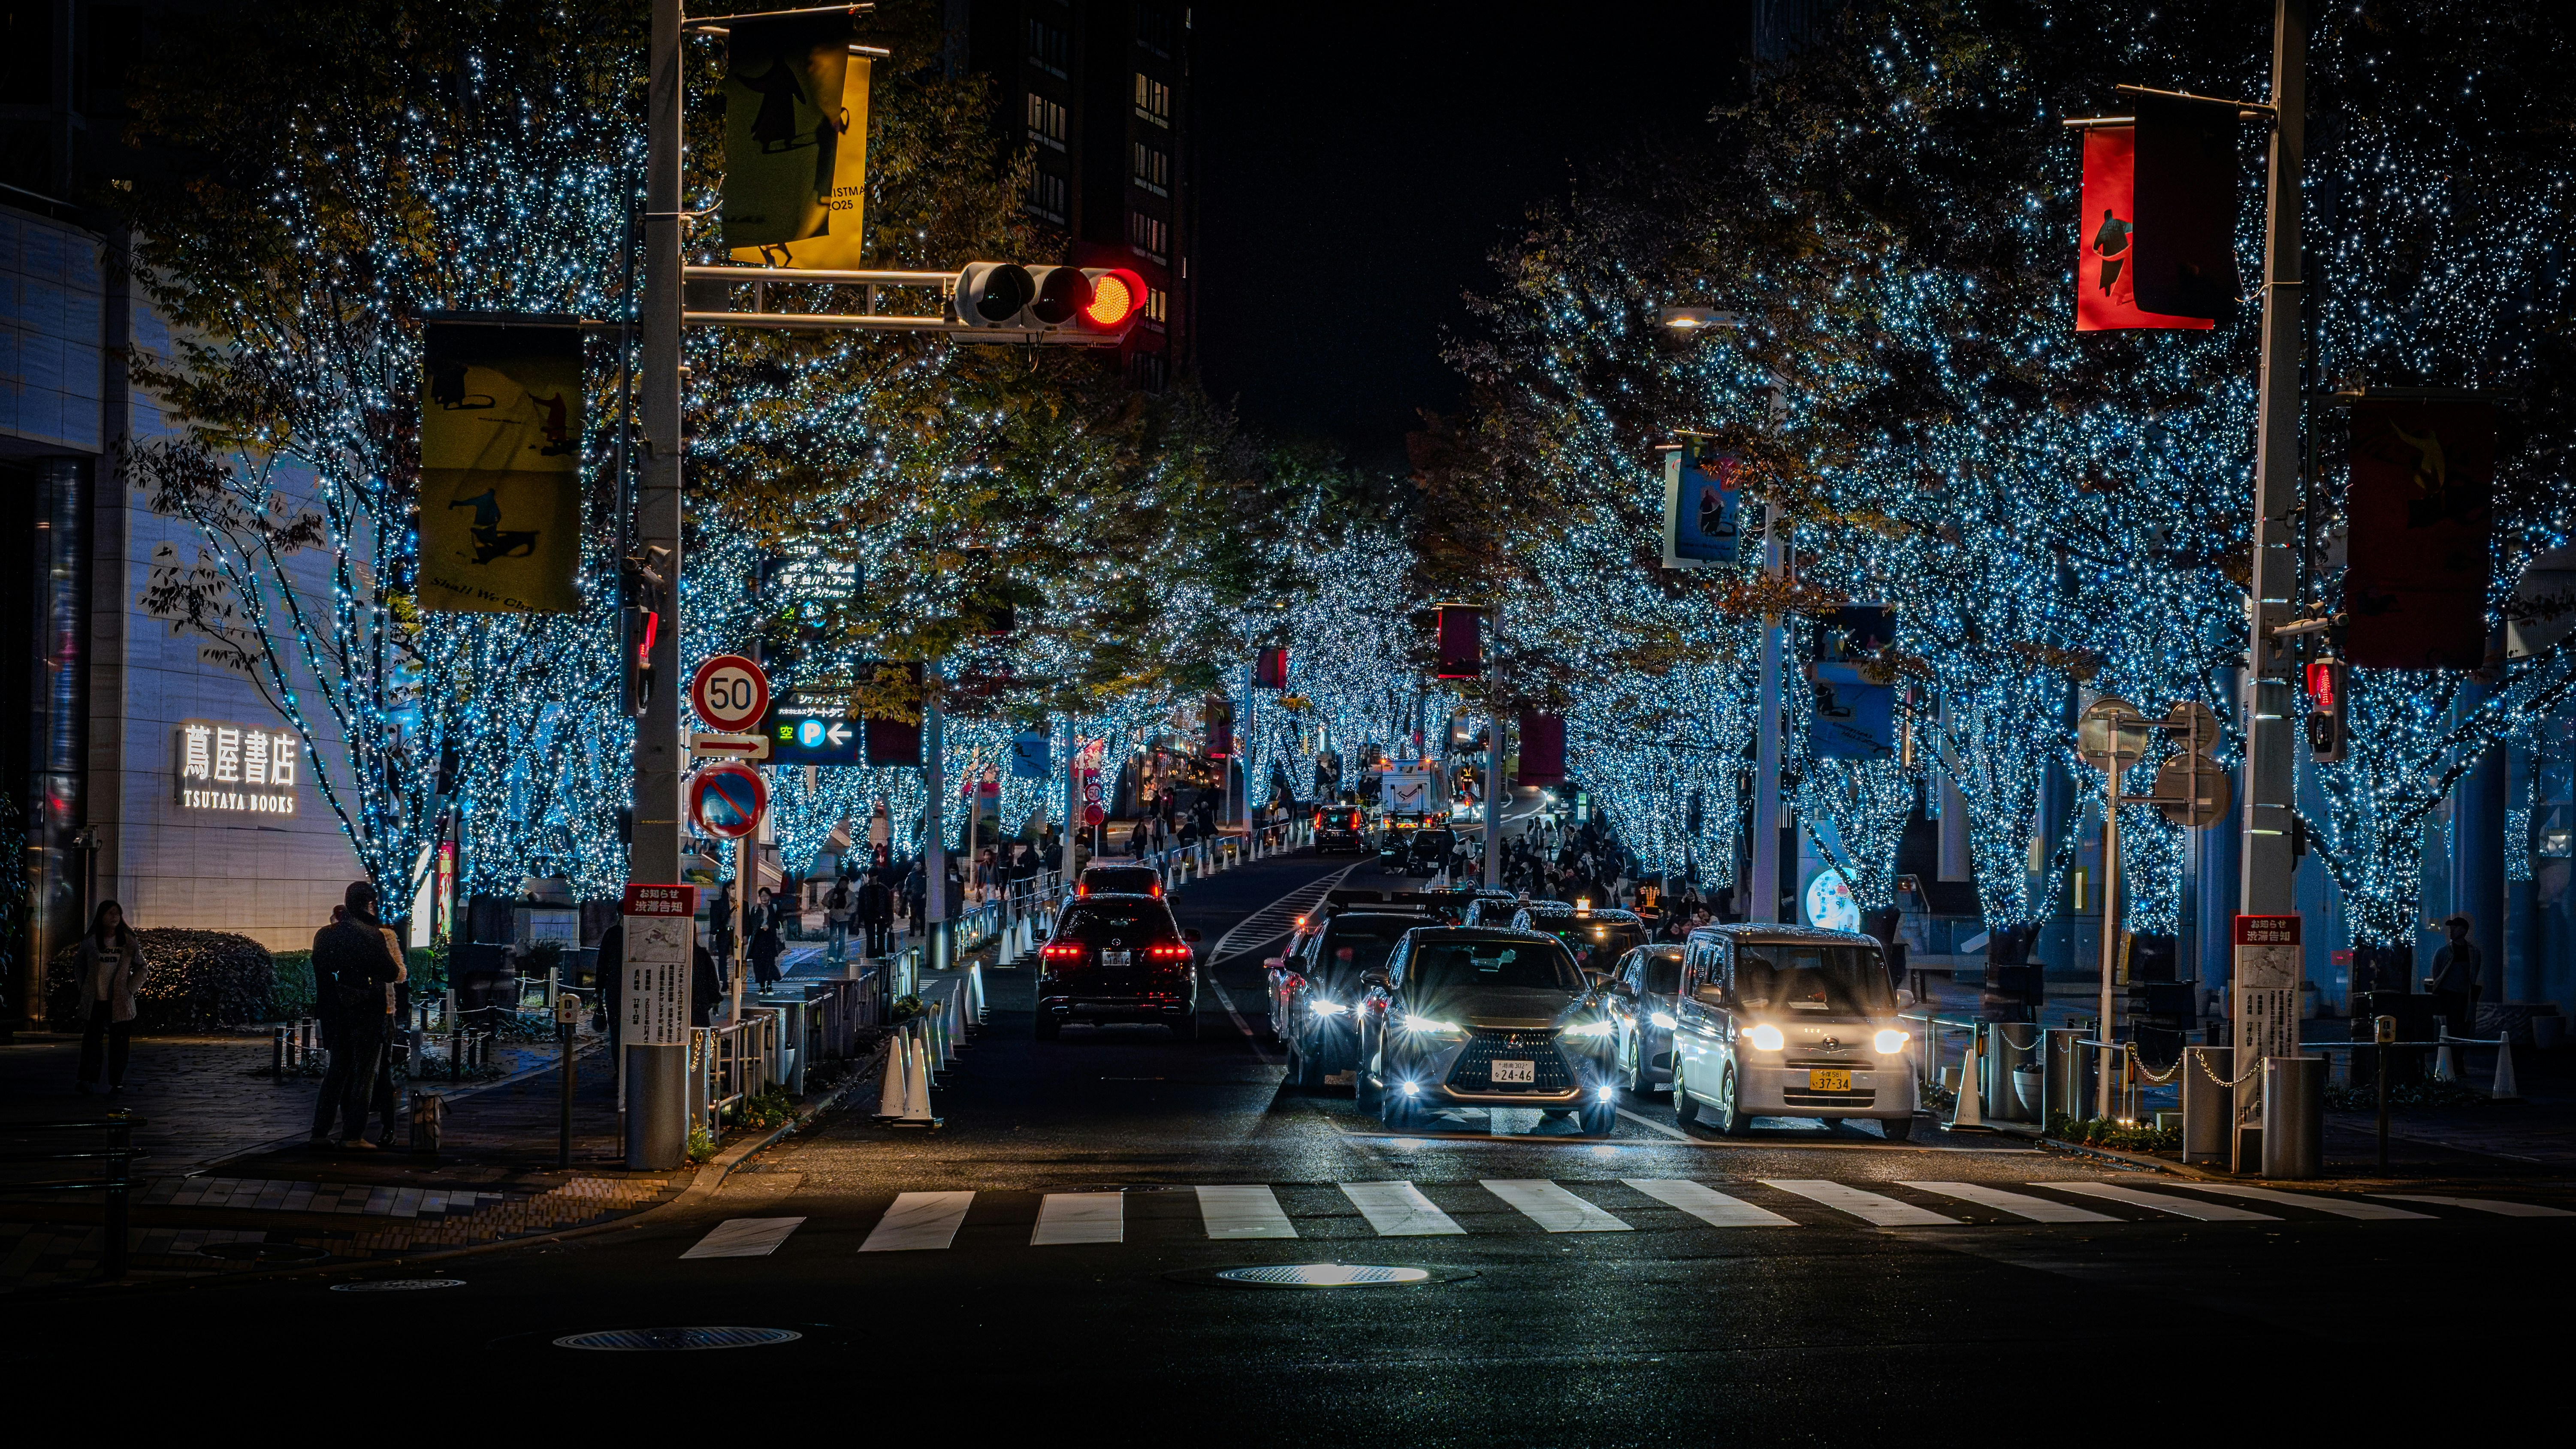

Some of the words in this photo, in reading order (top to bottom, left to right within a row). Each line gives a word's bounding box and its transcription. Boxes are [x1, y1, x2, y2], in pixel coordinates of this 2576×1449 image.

[833, 185, 864, 197] ISTMA
[830, 199, 853, 211] 025
[711, 677, 750, 710] 50
[779, 707, 846, 717] 六本木ヒルズゲートタワ
[780, 726, 793, 739] 空
[804, 723, 820, 743] P
[184, 724, 295, 786] 蔦屋書店
[1089, 788, 1099, 797] 50
[184, 790, 244, 809] TSUTAYA
[251, 795, 293, 813] BOOKS
[640, 888, 679, 899] お知らせ
[635, 900, 683, 912] 渋滞告知
[2250, 919, 2286, 929] お知らせ
[1501, 1070, 1531, 1081] 24-46
[1819, 1078, 1848, 1089] 37-34
